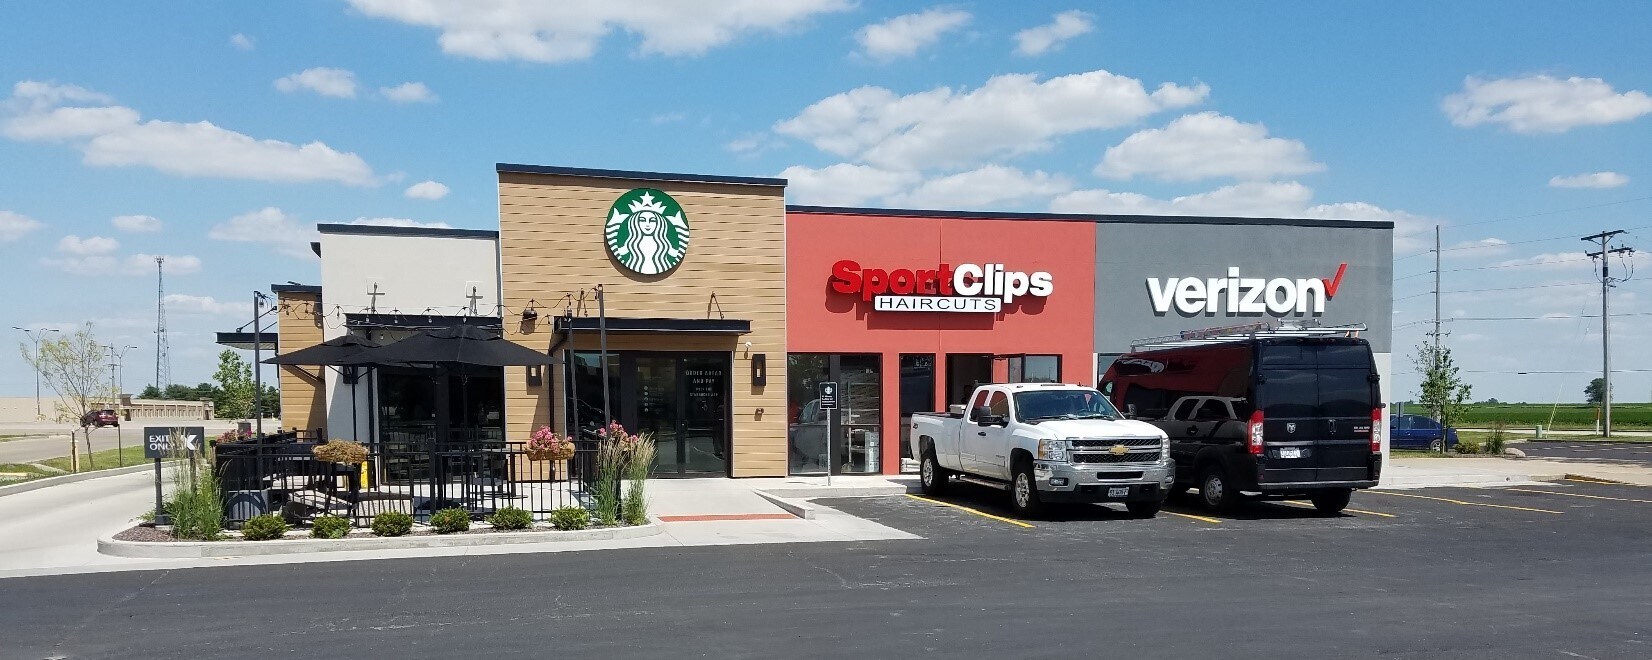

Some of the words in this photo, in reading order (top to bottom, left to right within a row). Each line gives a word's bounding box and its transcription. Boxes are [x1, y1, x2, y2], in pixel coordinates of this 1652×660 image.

[1147, 267, 1326, 313] verizon
[879, 298, 996, 310] HAIRCUTS
[149, 434, 170, 443] EXIT
[149, 442, 174, 451] ONL
